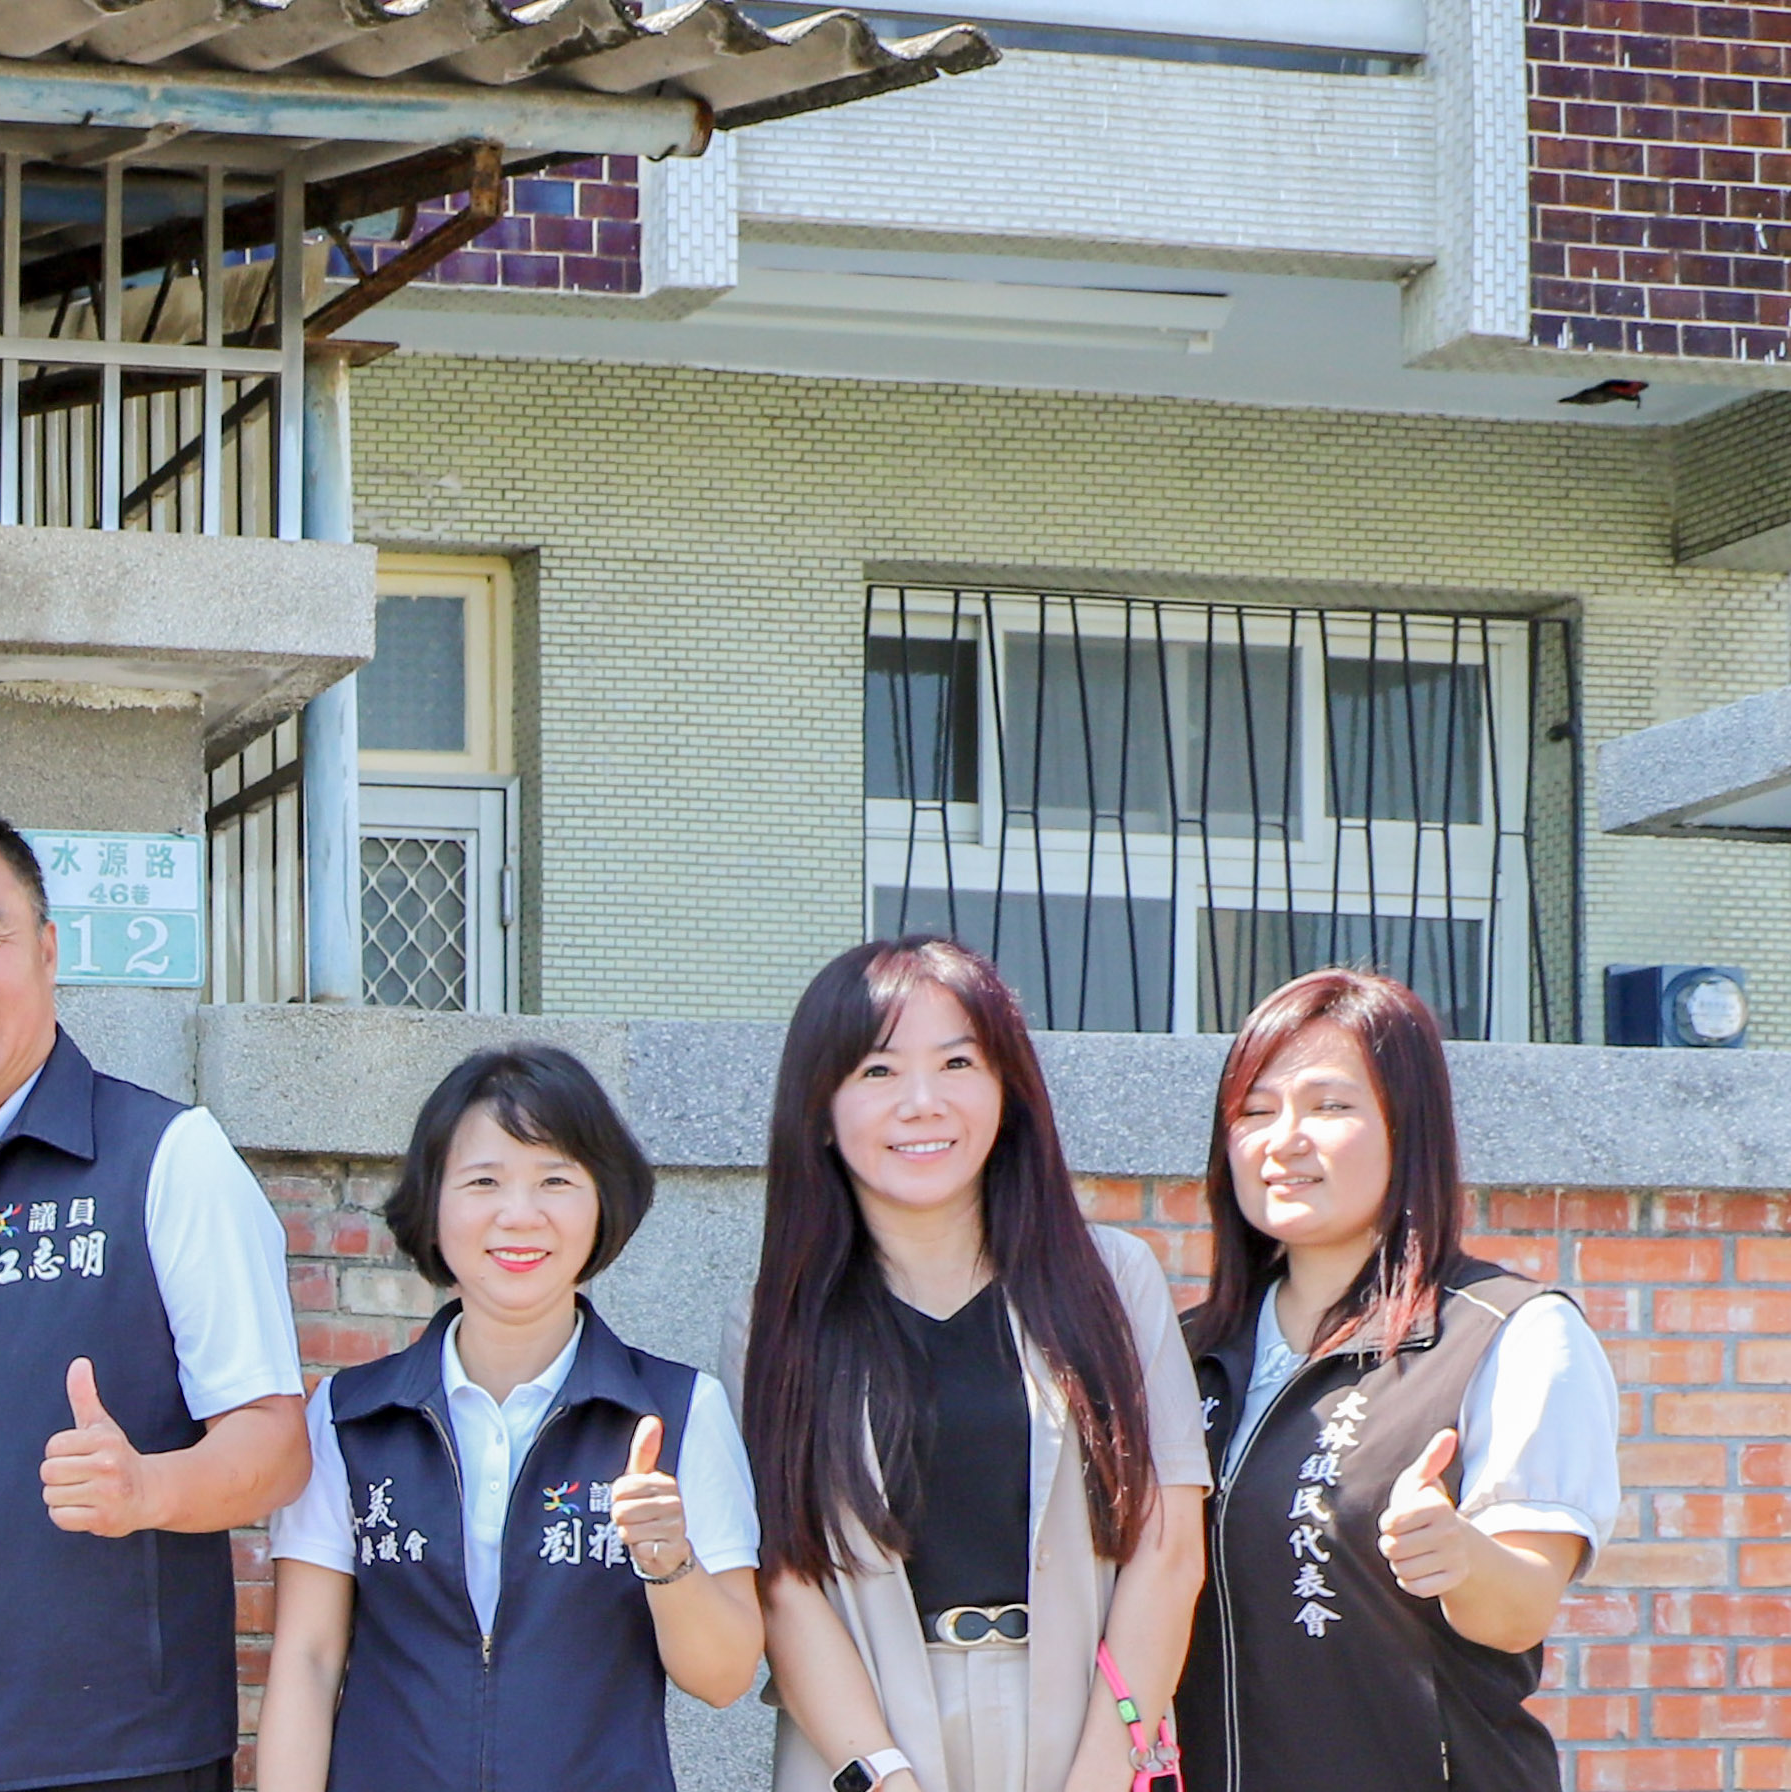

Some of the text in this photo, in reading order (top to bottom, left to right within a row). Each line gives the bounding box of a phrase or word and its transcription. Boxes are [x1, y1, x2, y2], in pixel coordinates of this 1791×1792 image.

[50, 840, 175, 879] 水源路
[88, 883, 150, 905] 46巷
[70, 914, 169, 975] 12
[28, 1197, 95, 1232] 議員
[1288, 1391, 1368, 1638] 大林鎮民代表會
